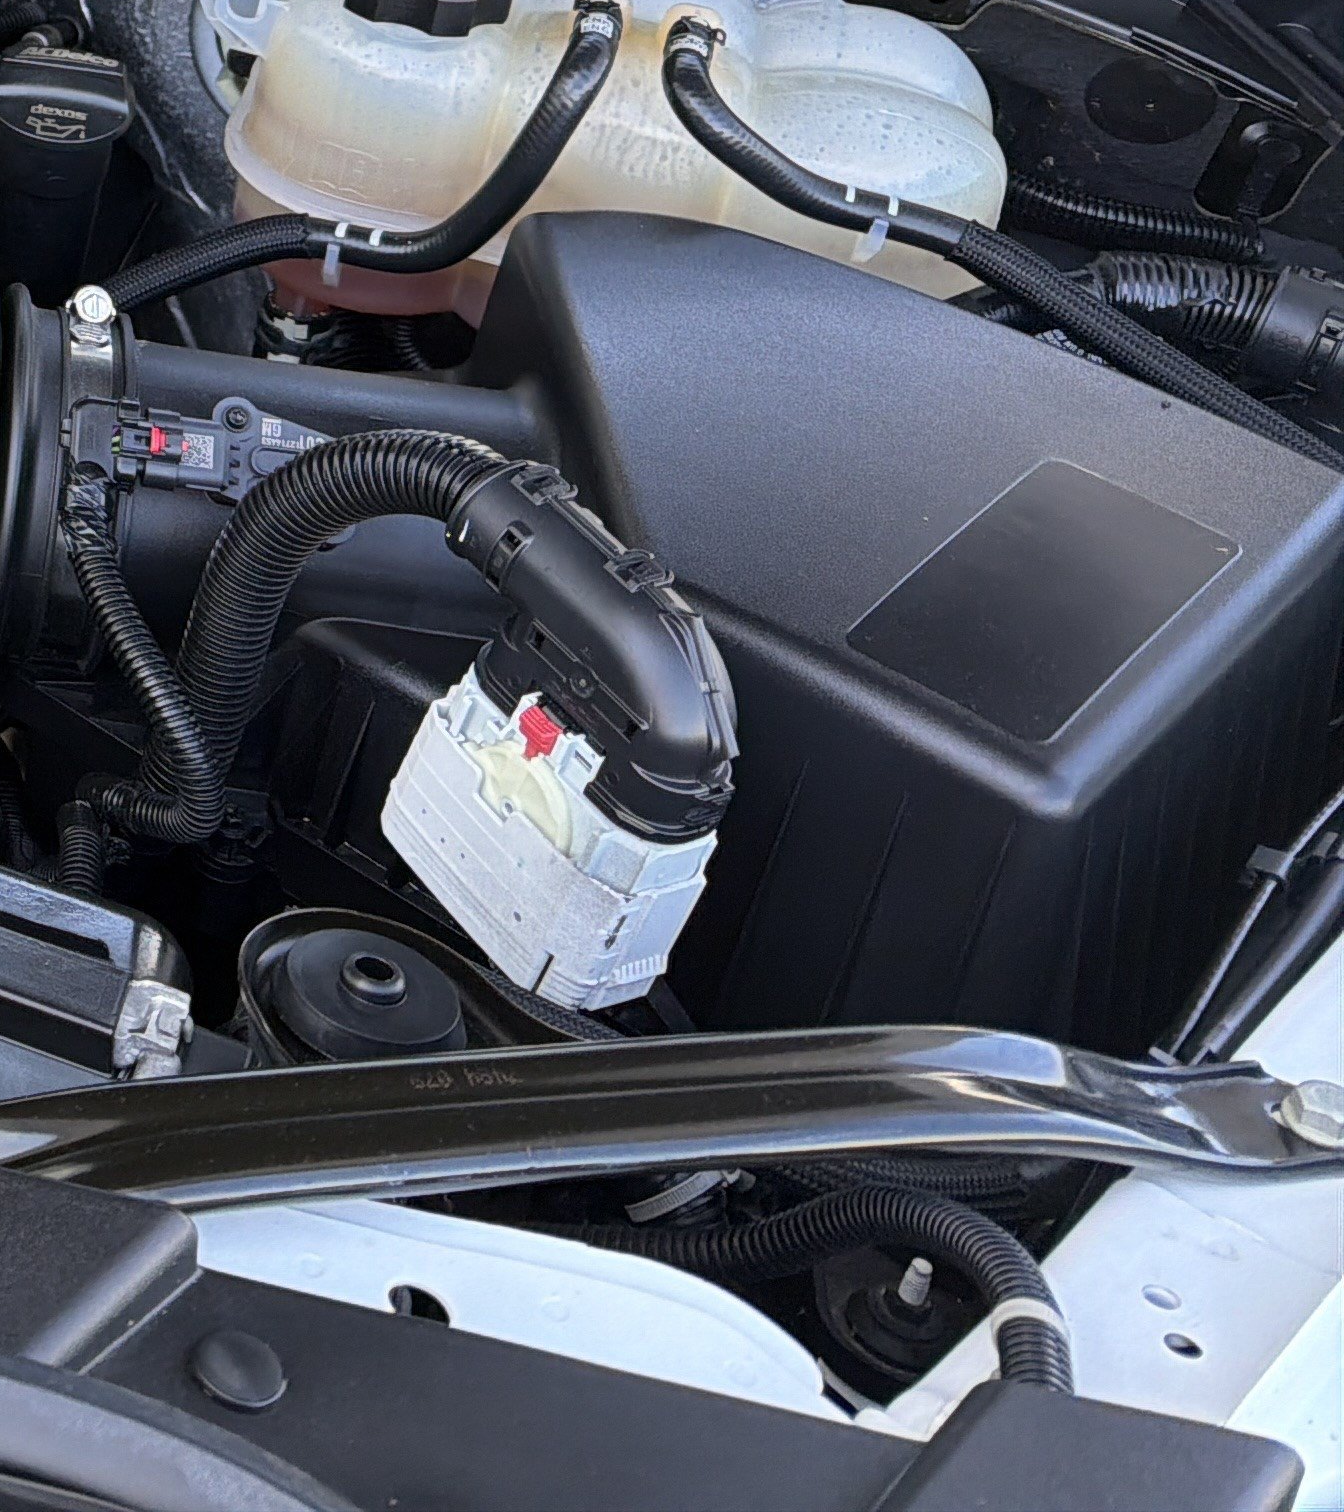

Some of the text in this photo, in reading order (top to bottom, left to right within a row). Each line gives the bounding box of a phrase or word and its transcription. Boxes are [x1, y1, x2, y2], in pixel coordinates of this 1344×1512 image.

[16, 46, 119, 67] ACDelco
[30, 104, 88, 121] dexos
[261, 420, 282, 438] GM
